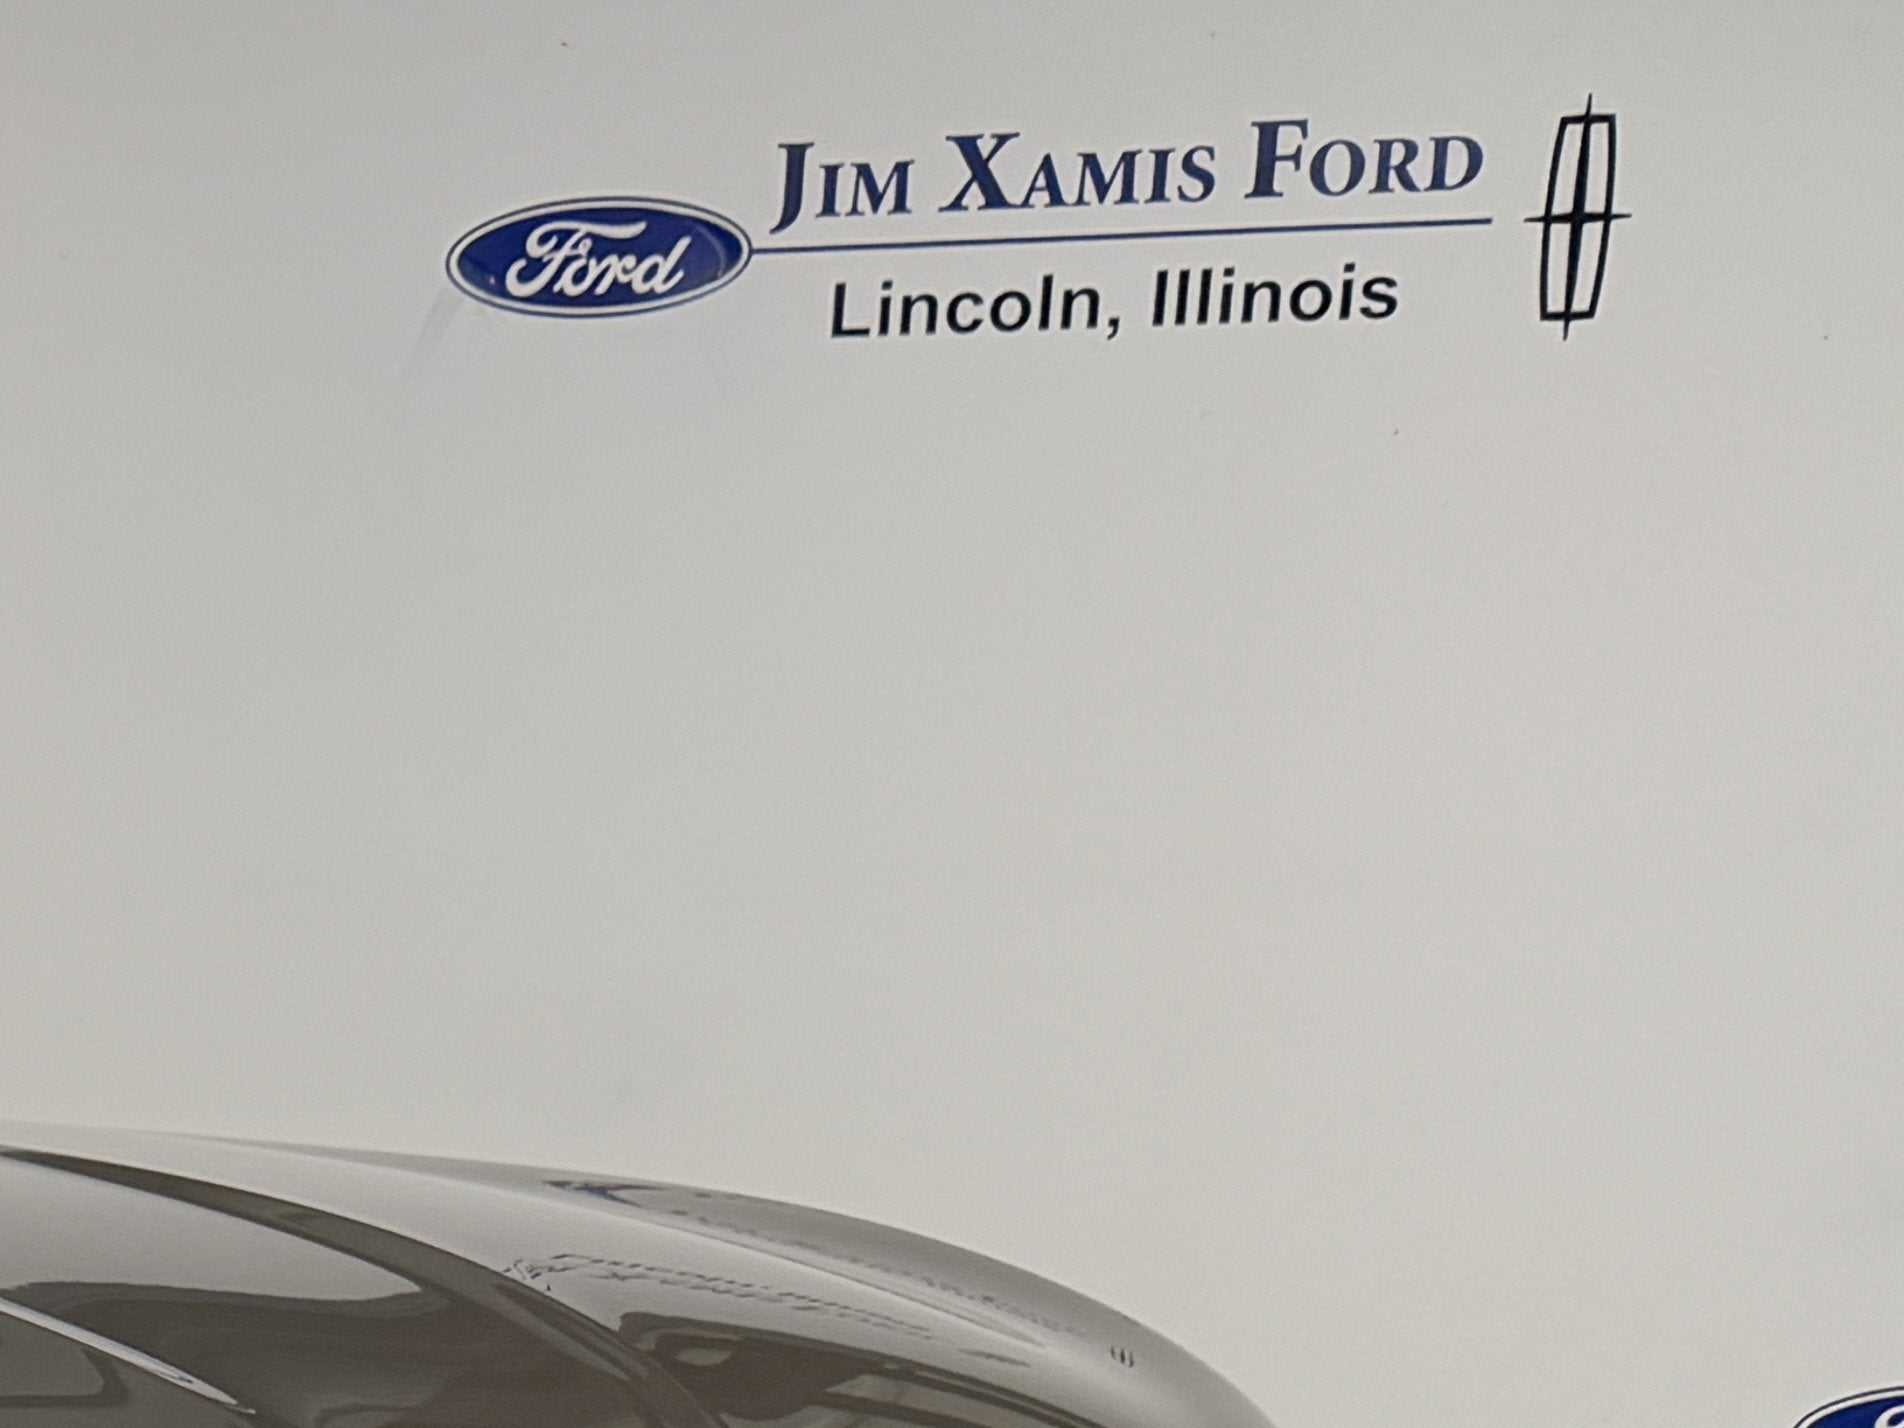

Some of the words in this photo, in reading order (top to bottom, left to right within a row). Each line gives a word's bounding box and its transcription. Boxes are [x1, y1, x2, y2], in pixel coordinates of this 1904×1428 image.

[769, 141, 915, 235] JIM
[937, 132, 1216, 212] XAMIS
[1243, 118, 1484, 199] FORD
[504, 220, 693, 298] Ford
[831, 273, 1121, 341] Lincoln,
[1151, 261, 1399, 327] Illinois
